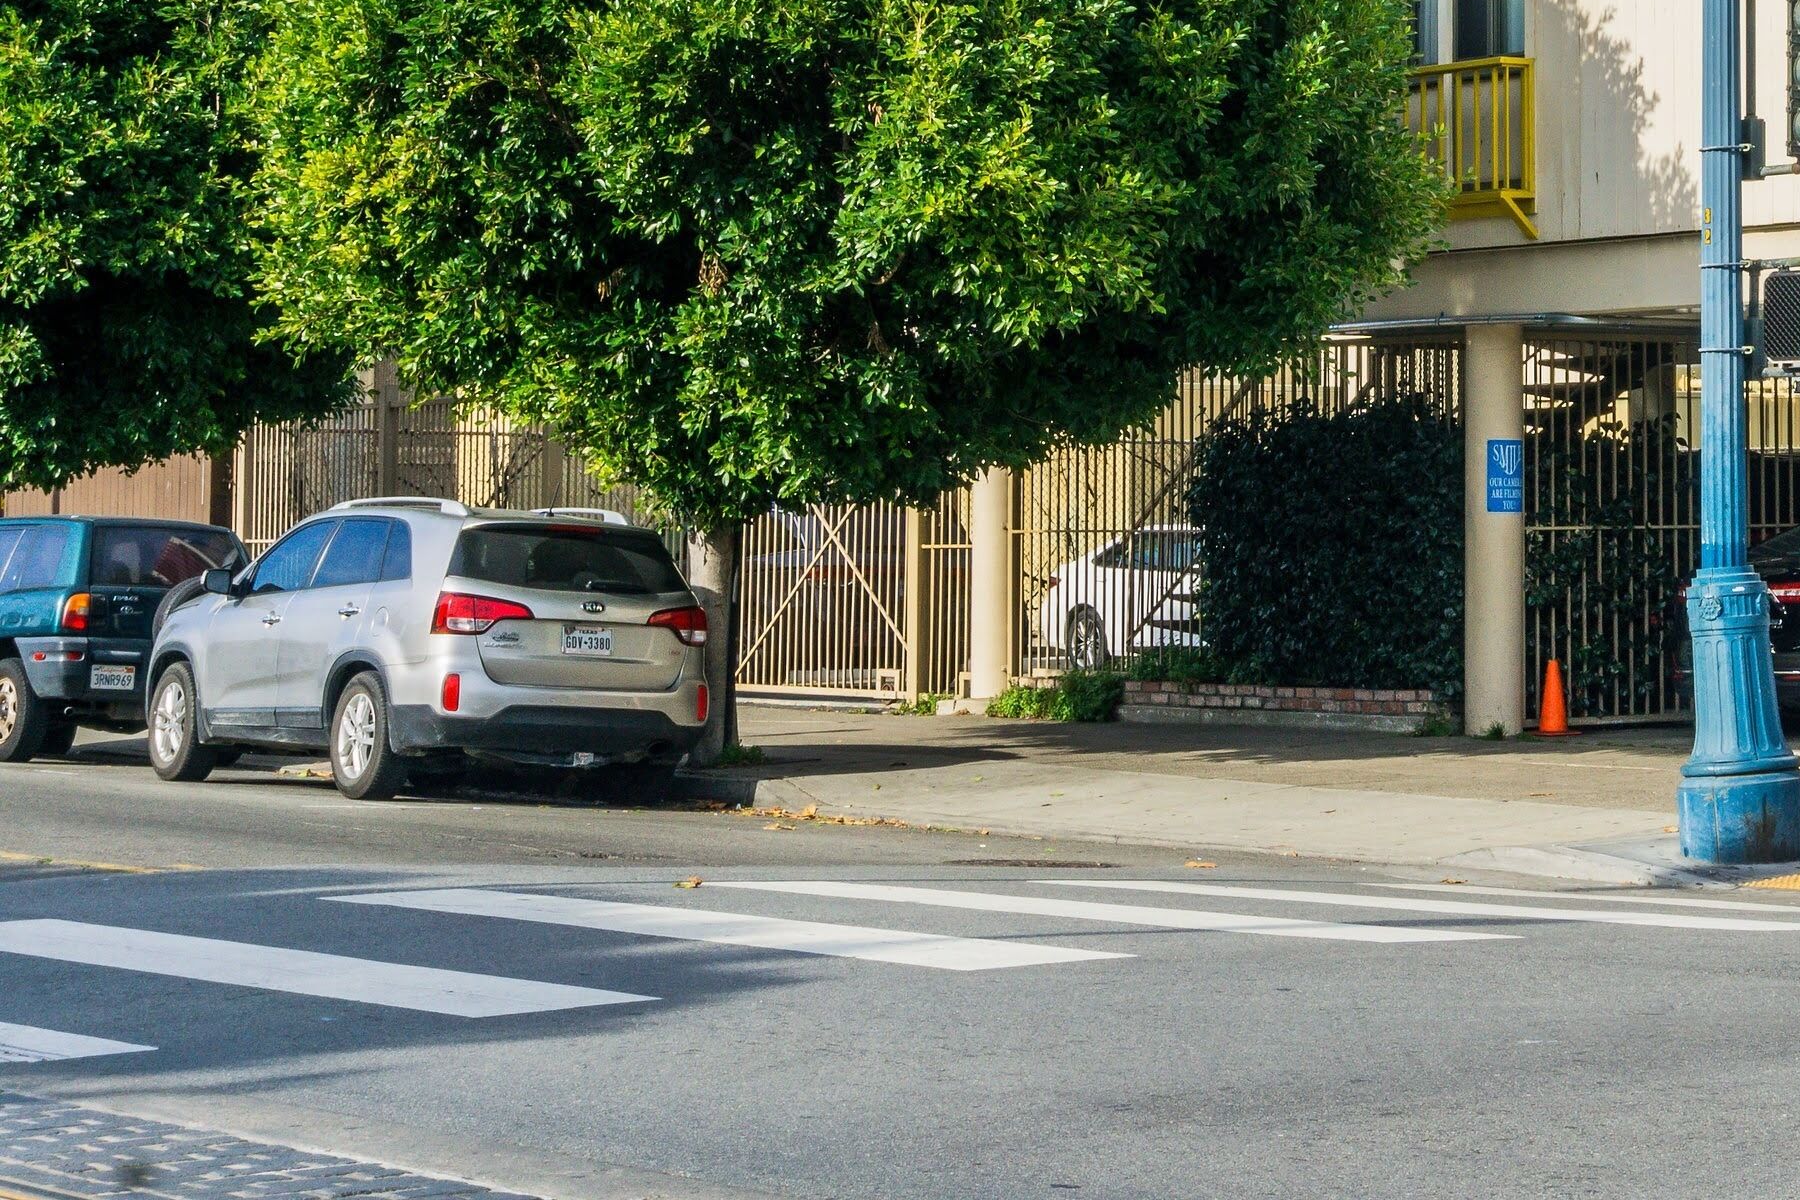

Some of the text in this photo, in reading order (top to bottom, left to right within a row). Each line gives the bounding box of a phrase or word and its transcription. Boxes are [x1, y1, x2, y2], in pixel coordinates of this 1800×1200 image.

[1490, 478, 1502, 487] OUR
[1491, 488, 1503, 498] ARE
[94, 674, 132, 687] 3RNR969
